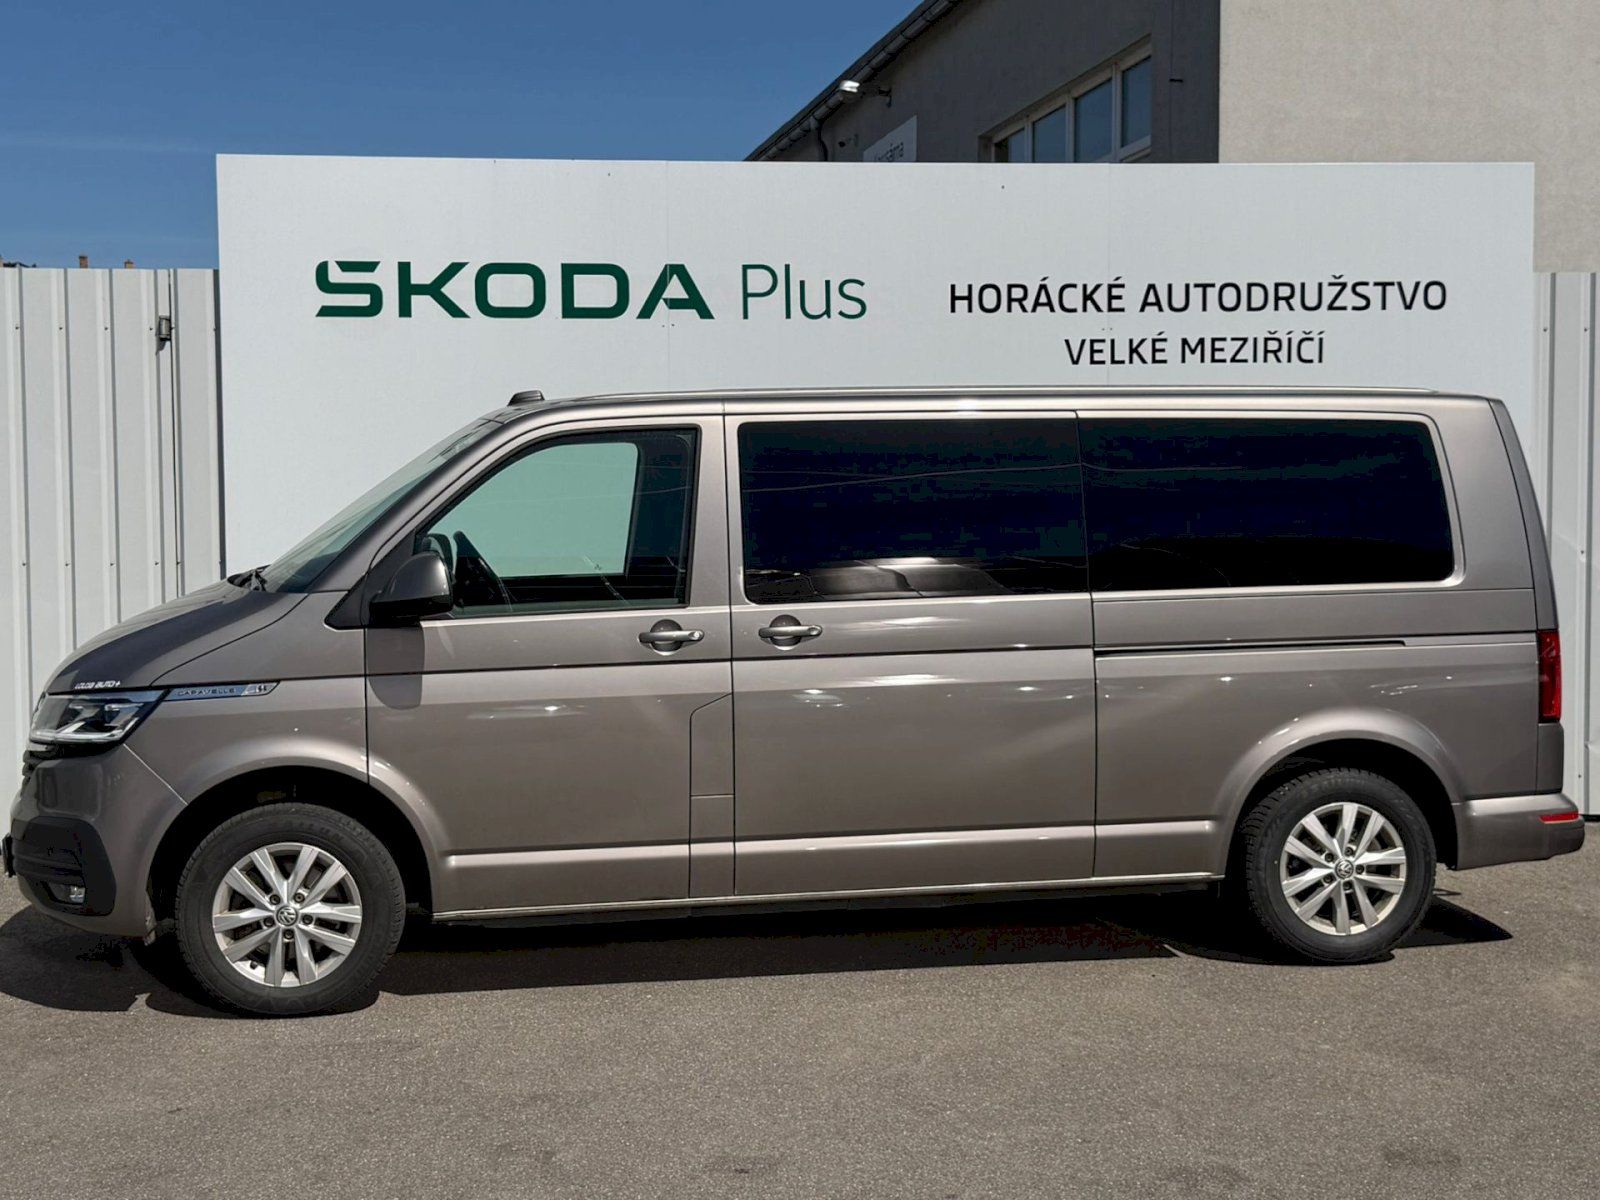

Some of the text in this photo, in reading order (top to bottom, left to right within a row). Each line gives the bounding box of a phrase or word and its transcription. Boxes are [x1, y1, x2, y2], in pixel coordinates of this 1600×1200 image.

[741, 263, 867, 321] Plus
[950, 274, 1447, 314] HORÁCKÉ AUTODRUŽSTVO
[1063, 330, 1325, 366] VELKÉ MEZIŘÍČÍ
[177, 687, 236, 697] CARAVELLE
